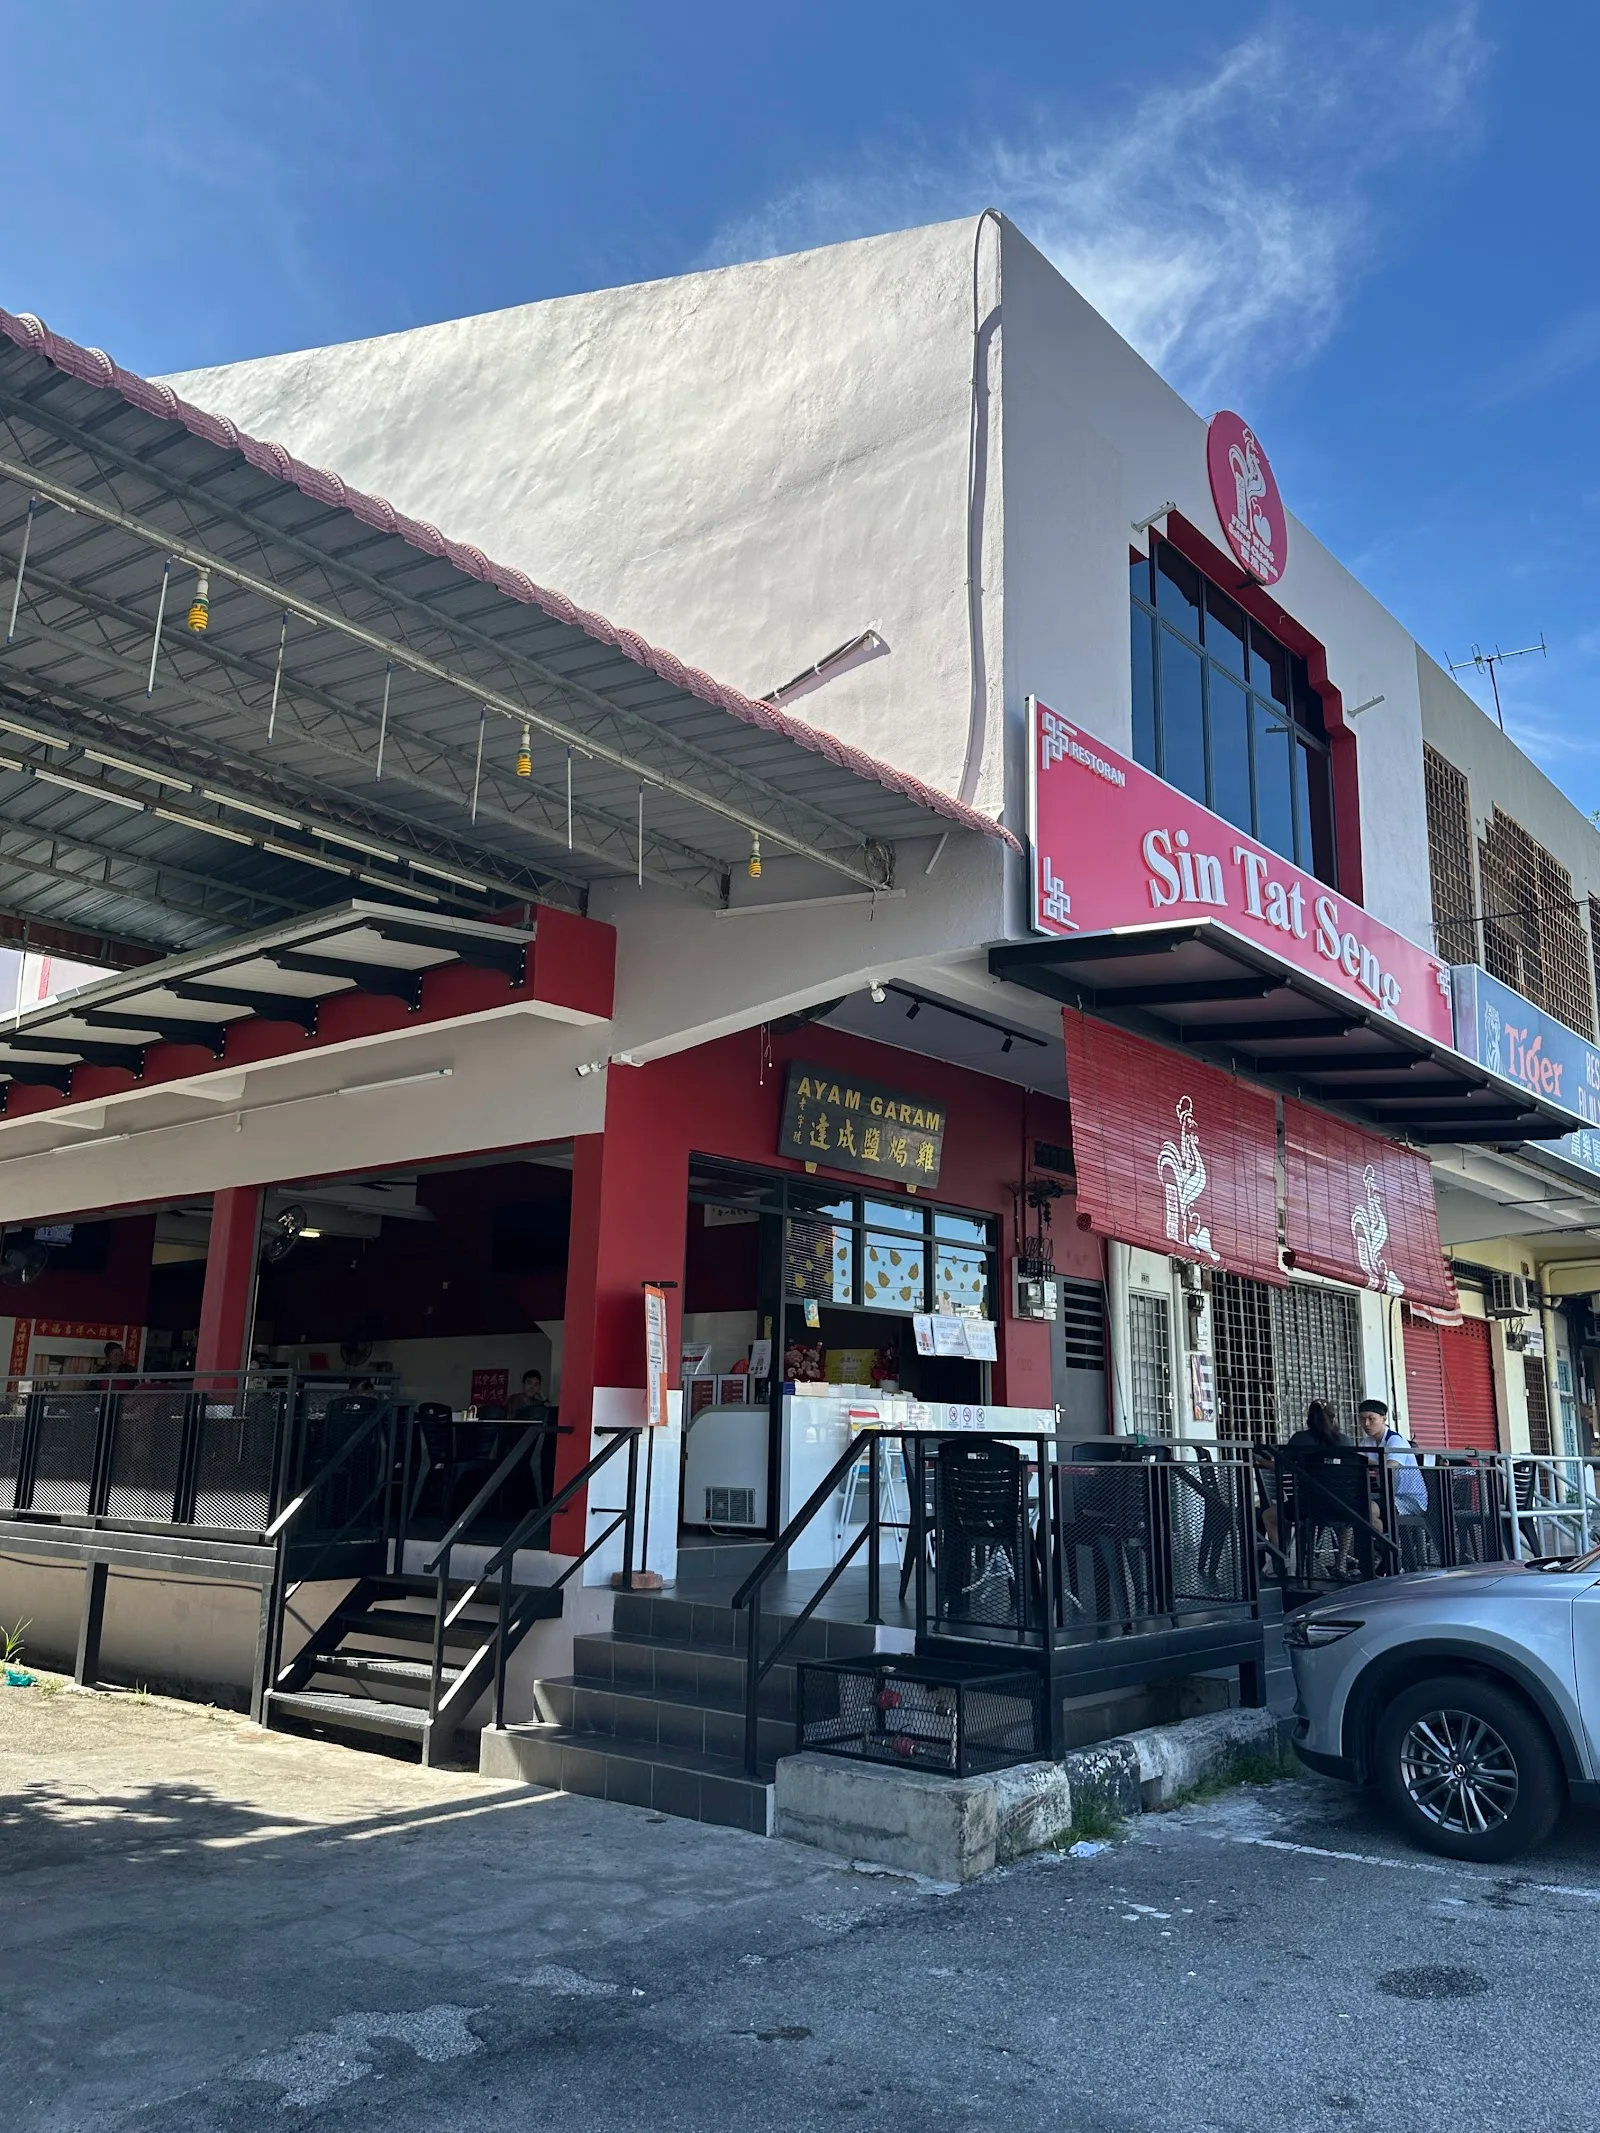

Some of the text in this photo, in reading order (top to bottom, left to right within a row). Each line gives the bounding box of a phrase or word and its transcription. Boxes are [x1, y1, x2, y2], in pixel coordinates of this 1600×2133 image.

[1071, 741, 1126, 788] RESTORAN
[1142, 828, 1402, 1021] Sin Tat Seng
[1504, 1023, 1564, 1097] Tiger
[797, 1076, 940, 1132] AYAM GARAM
